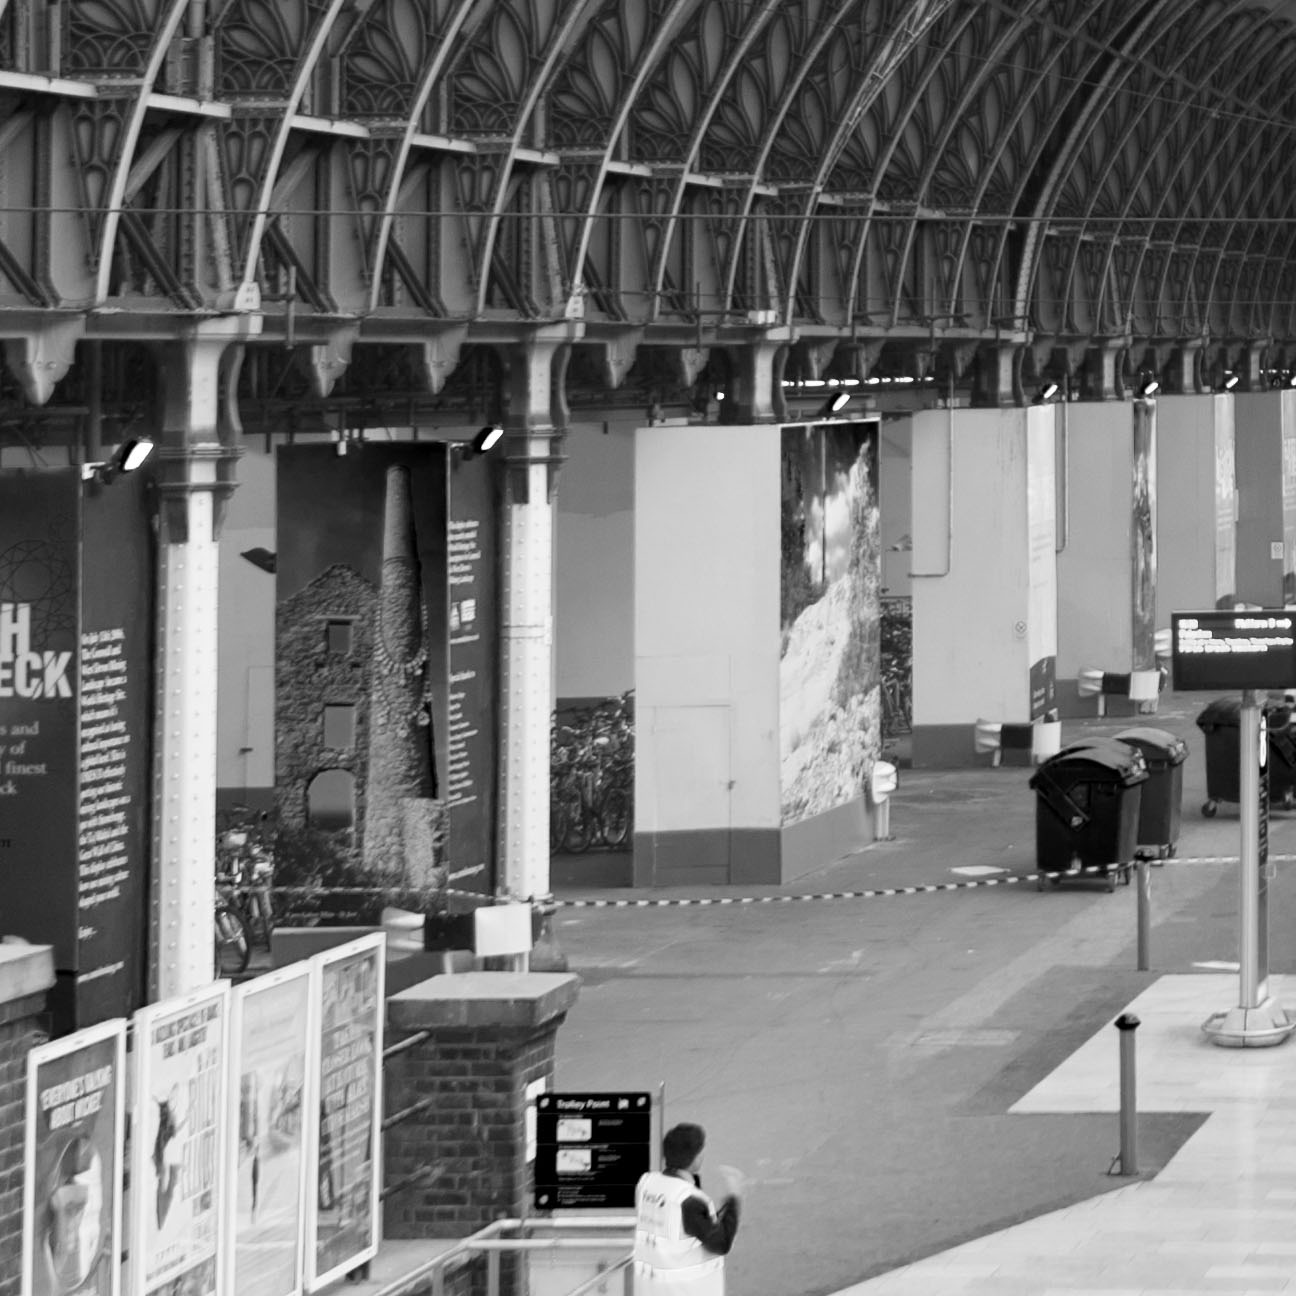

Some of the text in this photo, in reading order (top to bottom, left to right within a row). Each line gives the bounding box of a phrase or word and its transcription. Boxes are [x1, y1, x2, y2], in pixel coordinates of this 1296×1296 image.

[11, 720, 40, 736] and
[5, 760, 48, 775] finest
[556, 1099, 611, 1110] Trolley Point
